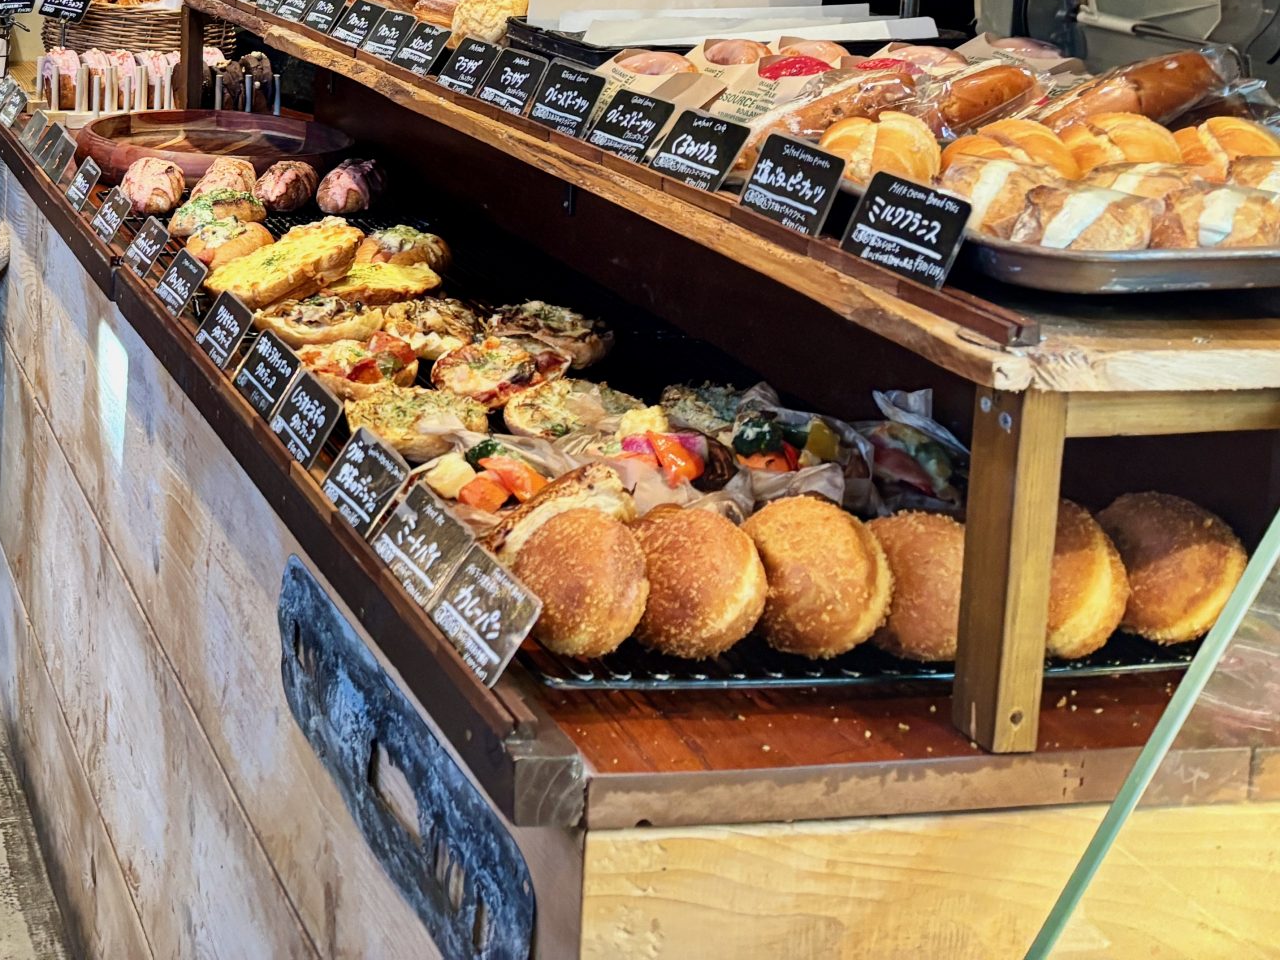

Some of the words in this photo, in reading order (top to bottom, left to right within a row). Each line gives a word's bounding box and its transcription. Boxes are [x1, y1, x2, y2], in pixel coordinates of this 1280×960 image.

[456, 56, 484, 74] マラサダ
[501, 66, 530, 87] マラサダ
[544, 83, 591, 114] グレーズドーナツ
[606, 104, 657, 134] グレーズドーナツ
[672, 133, 718, 164] くるみカフェ
[752, 159, 826, 204] 塩バターピーナッツ
[868, 196, 942, 245] ミルクフランス
[396, 517, 442, 571] ミートパイ
[453, 584, 502, 641] カレーパン
